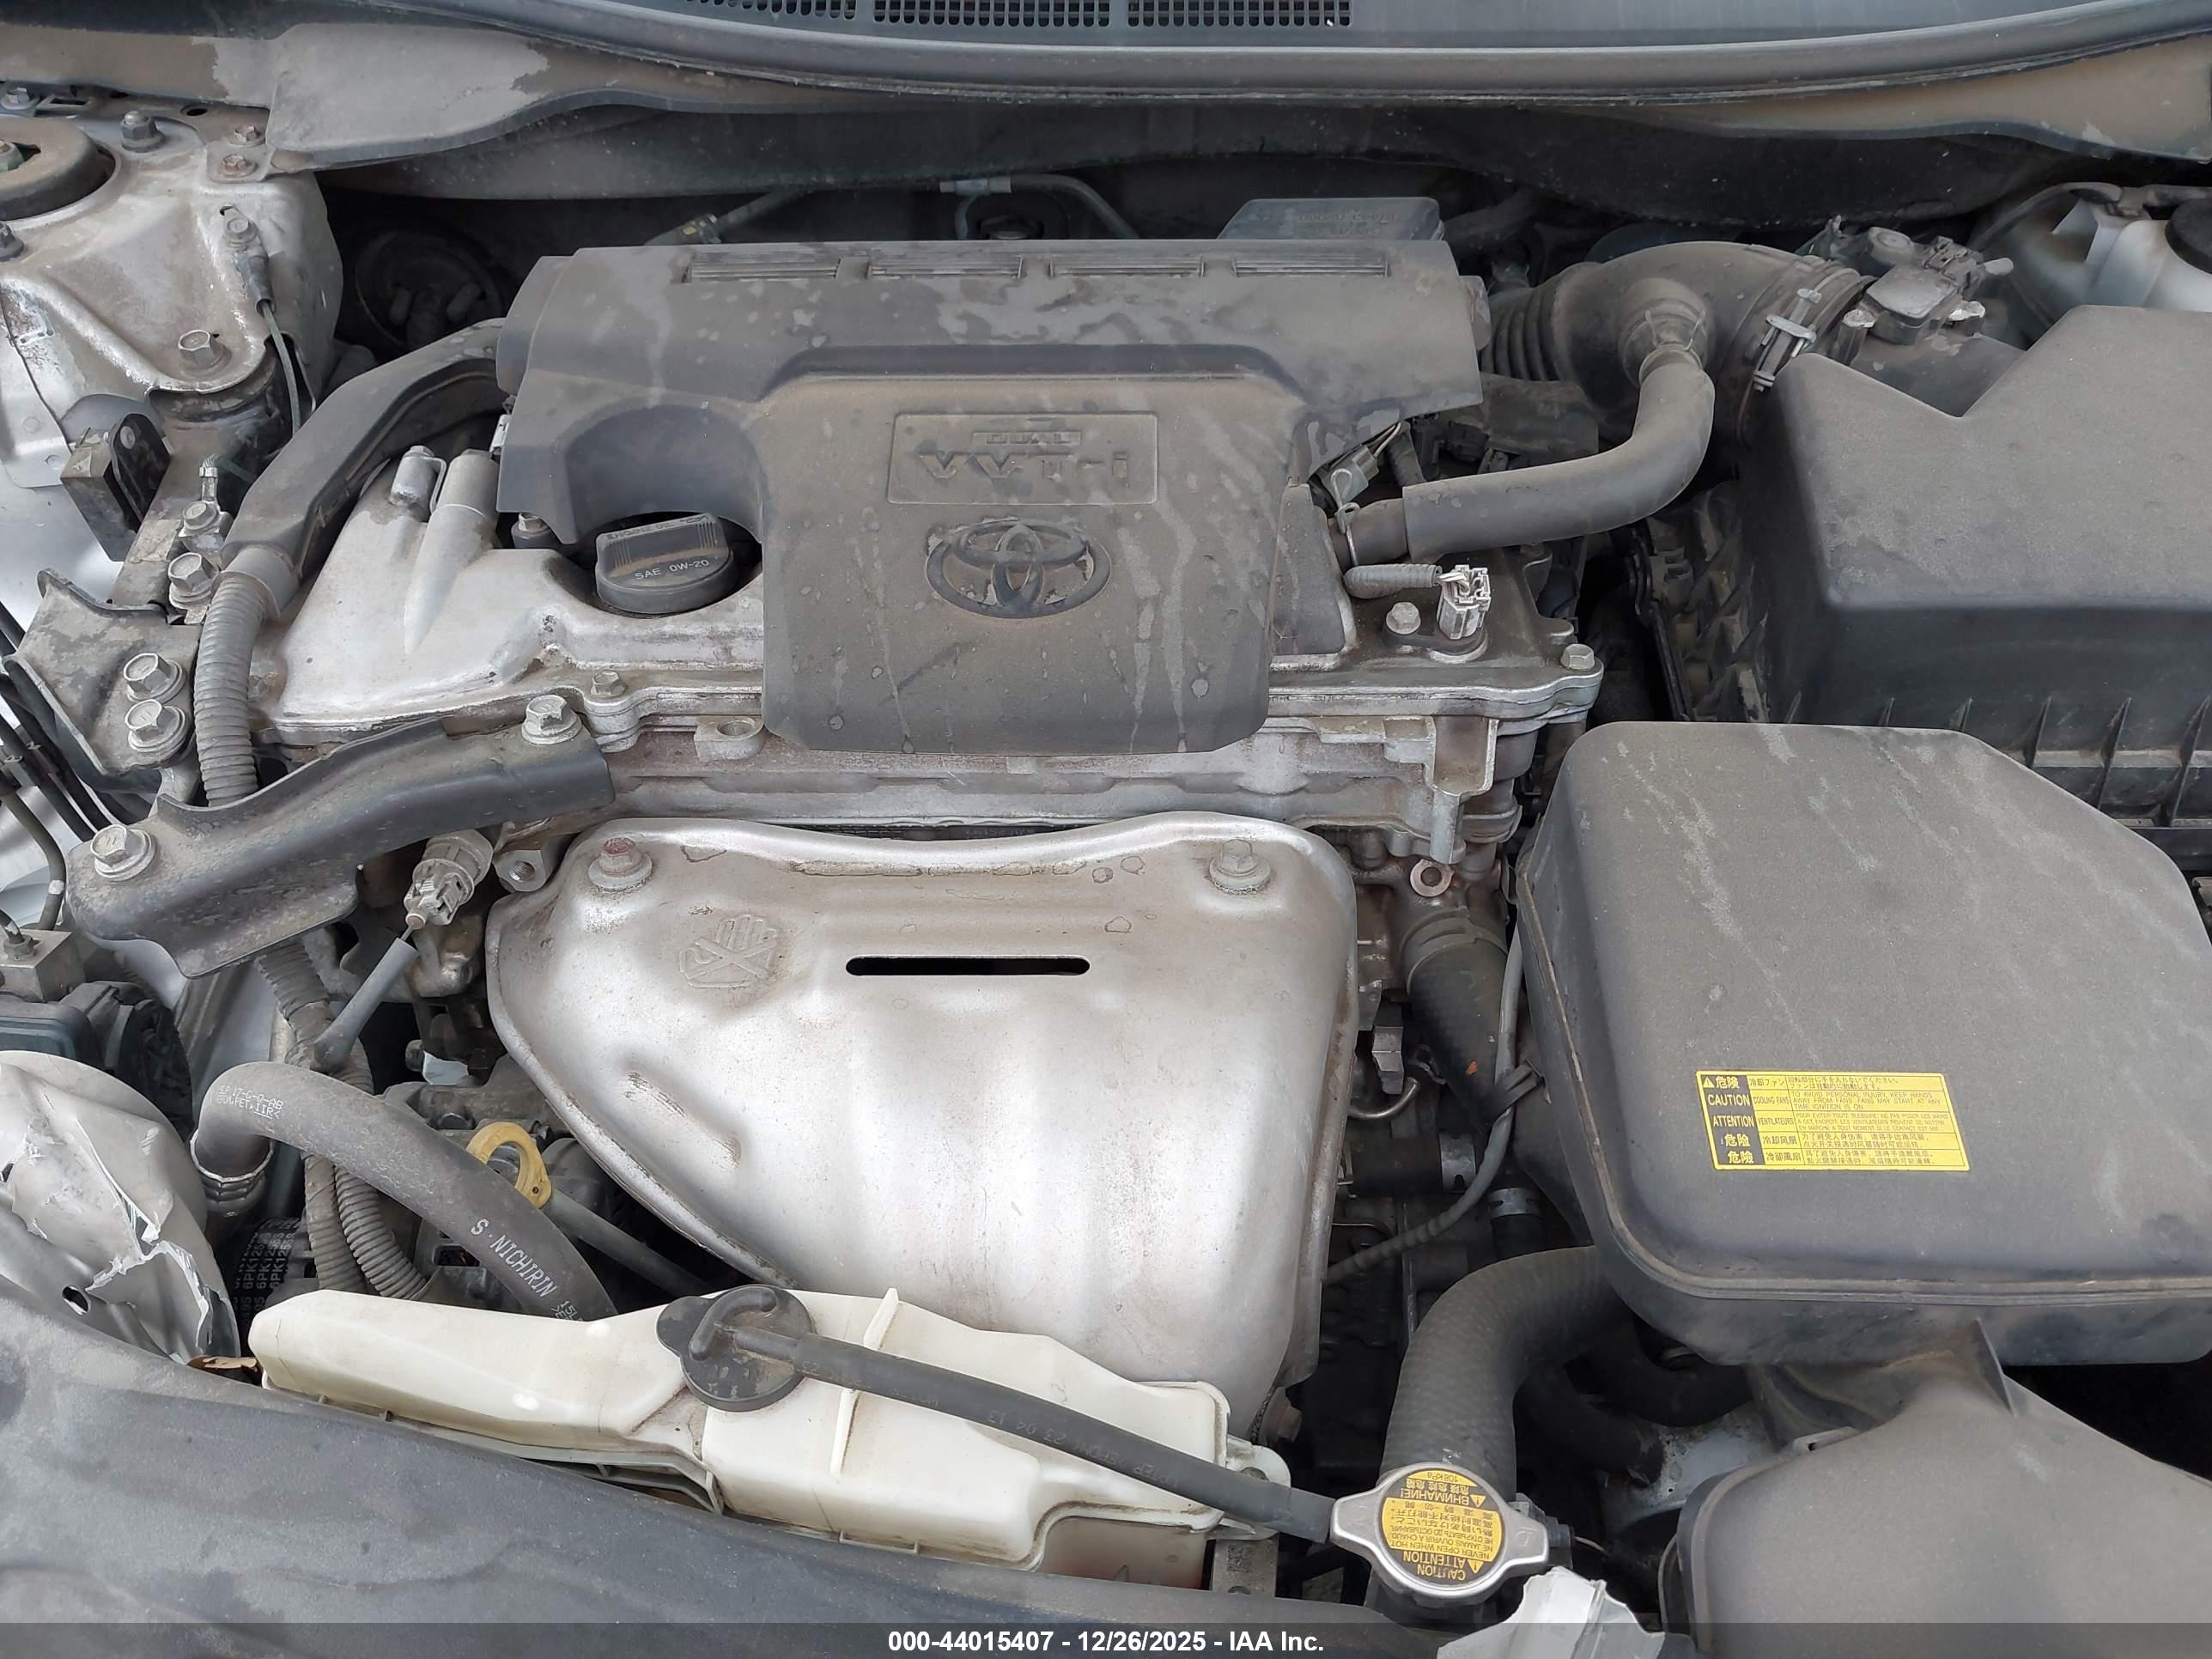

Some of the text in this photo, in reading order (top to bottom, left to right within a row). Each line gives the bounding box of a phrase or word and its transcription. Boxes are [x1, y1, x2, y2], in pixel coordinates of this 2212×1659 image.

[635, 559, 709, 580] SAE 0W-20
[1716, 1076, 1740, 1089] 危険
[1750, 1079, 1785, 1087] 冷却ファン
[1708, 1094, 1750, 1106] CAUTION
[1753, 1096, 1789, 1104] COOLING FANS
[1713, 1115, 1754, 1127] ATTENTION
[1759, 1117, 1794, 1126] VENTILATEURS
[1724, 1133, 1751, 1147] 危险
[1762, 1136, 1798, 1146] 冷却风扇
[1728, 1151, 1754, 1164] 危險
[489, 1234, 558, 1297] NICHIRIN
[1401, 1488, 1469, 1505] ВНИМАНИЕ!
[1410, 1542, 1434, 1551] WHEN
[1426, 1536, 1453, 1545] OUVRIR
[1455, 1540, 1480, 1549] JAMAIS
[1437, 1546, 1460, 1554] OPEN
[1462, 1549, 1489, 1559] NEVER
[1403, 1552, 1466, 1568] ATTENTION
[1417, 1564, 1467, 1581] CAUTION
